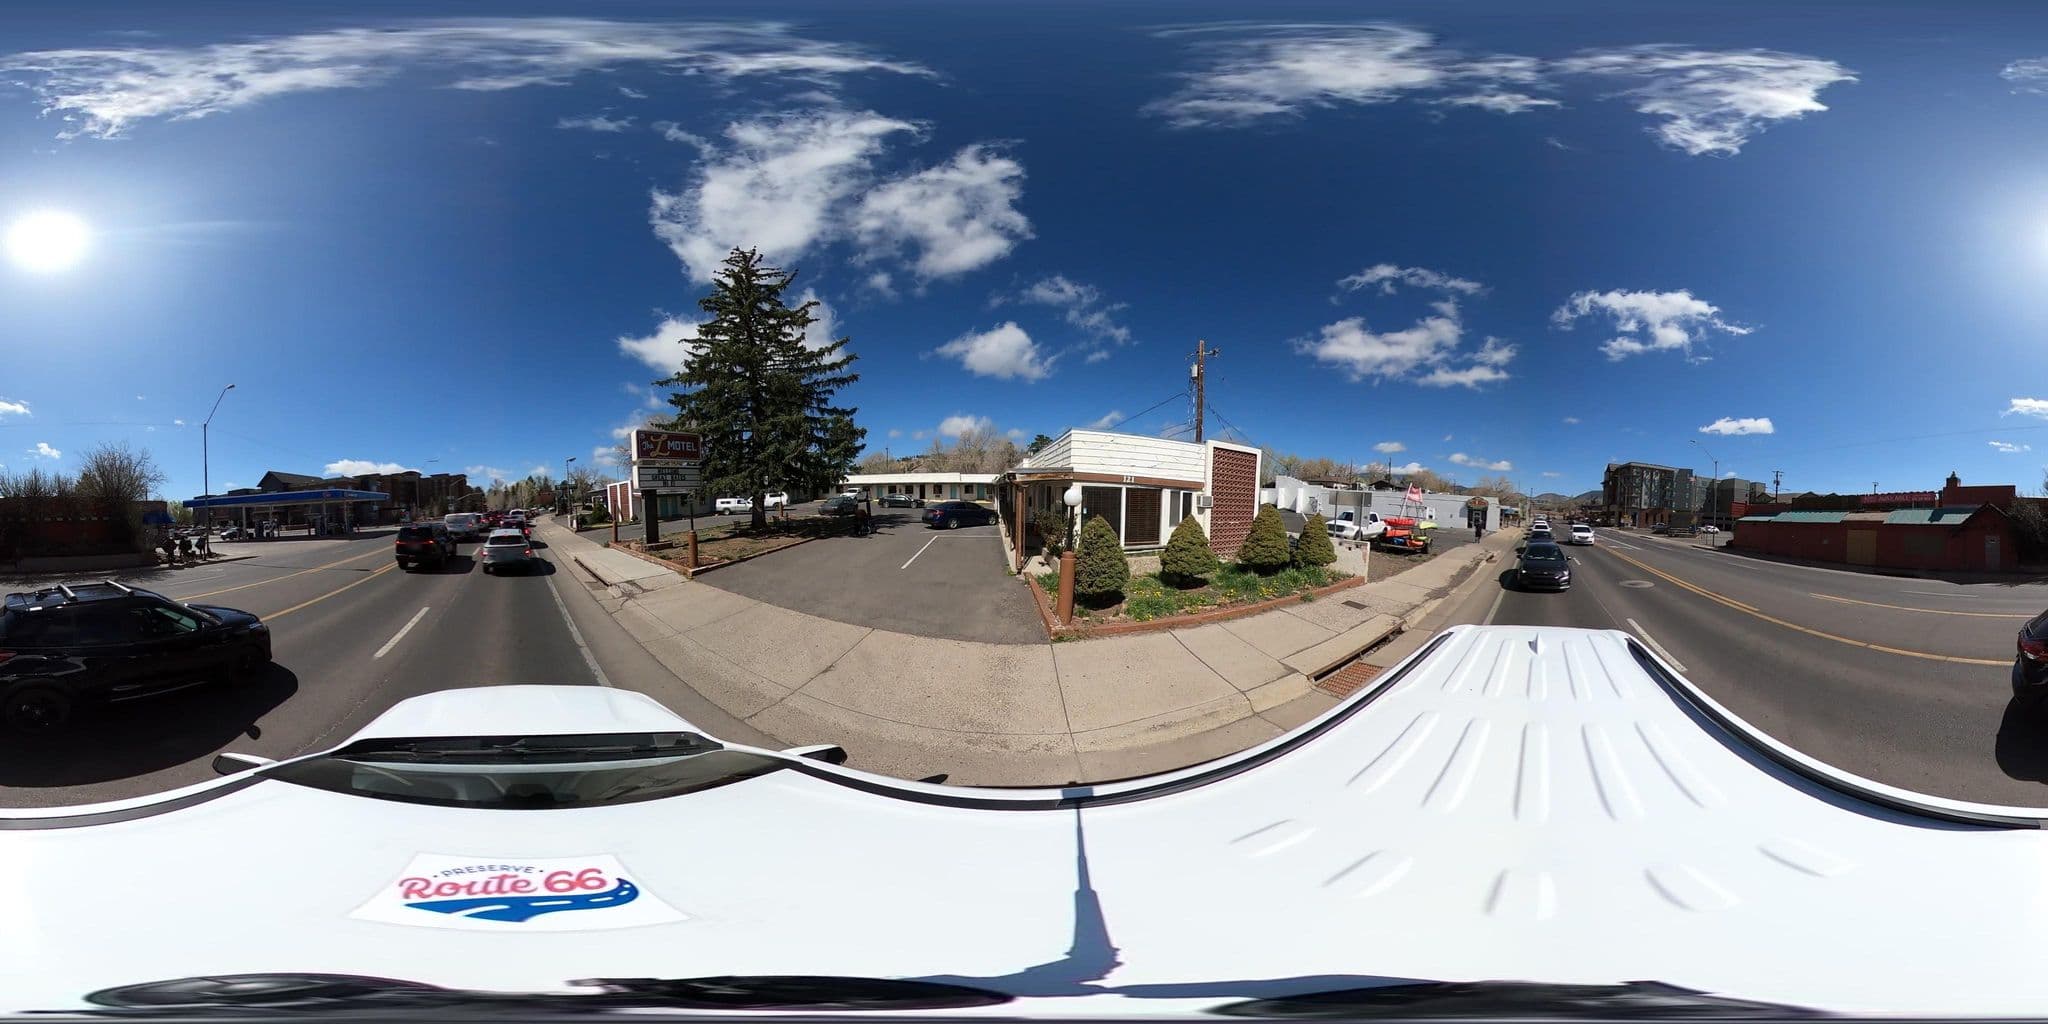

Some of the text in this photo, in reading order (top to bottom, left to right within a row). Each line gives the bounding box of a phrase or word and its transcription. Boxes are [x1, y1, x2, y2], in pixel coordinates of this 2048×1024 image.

[668, 440, 697, 451] MOTEL
[1123, 475, 1135, 483] 121
[444, 864, 535, 878] PRESERVE
[398, 868, 607, 899] Route 66
